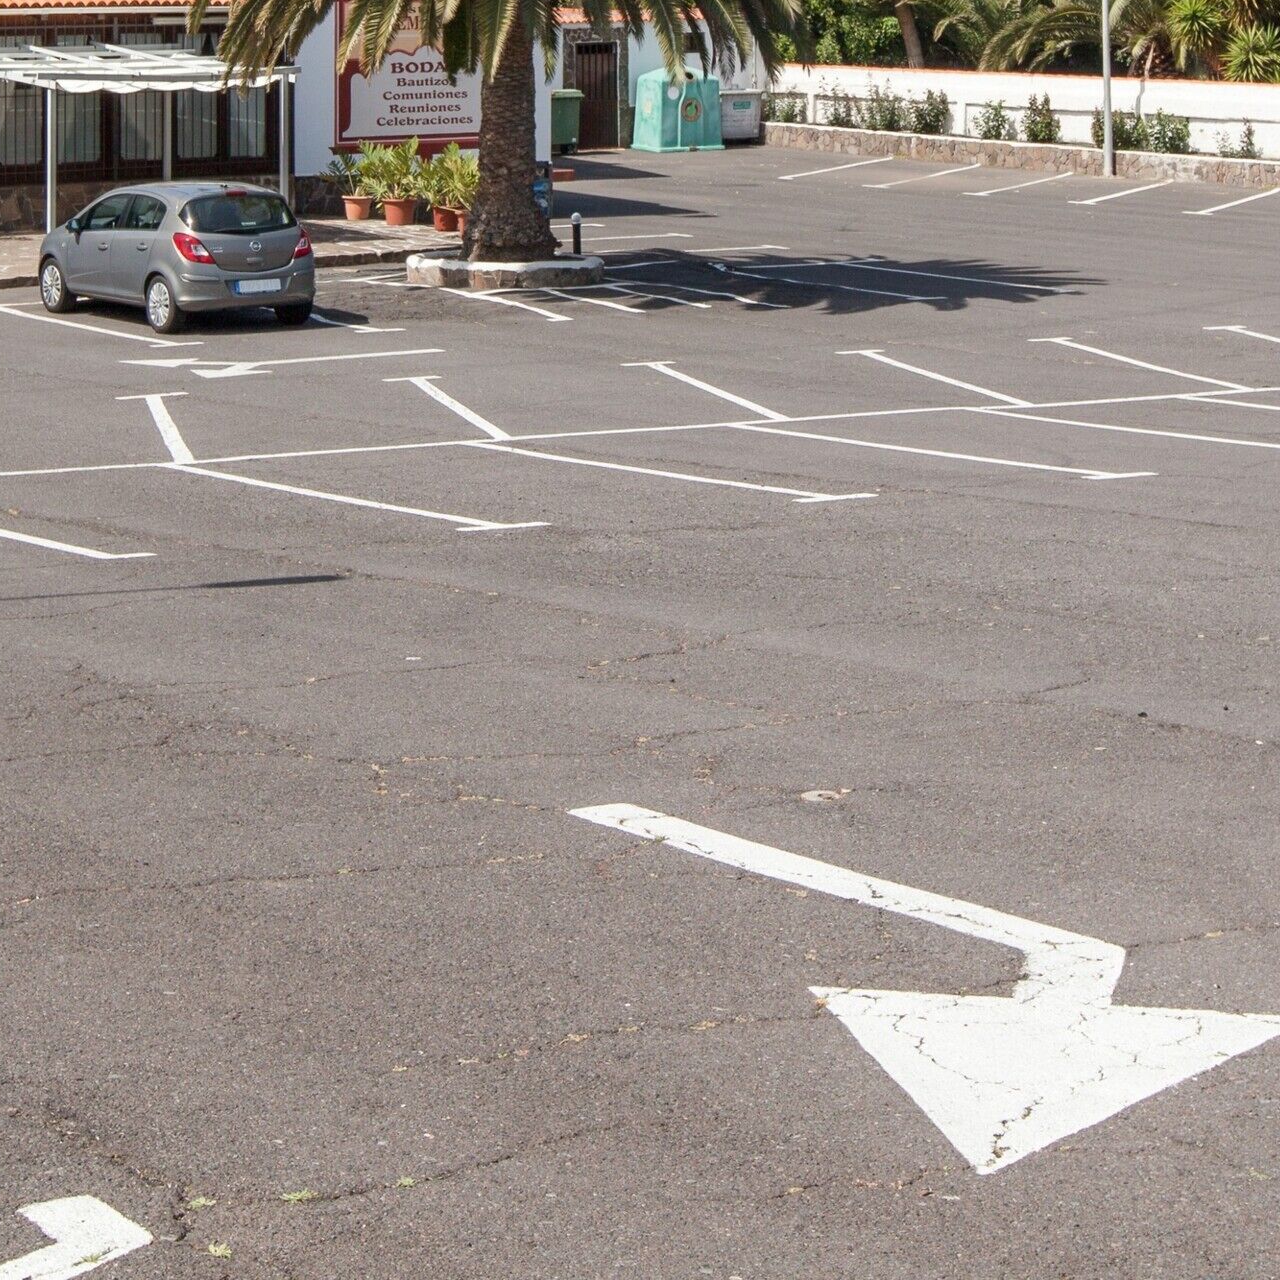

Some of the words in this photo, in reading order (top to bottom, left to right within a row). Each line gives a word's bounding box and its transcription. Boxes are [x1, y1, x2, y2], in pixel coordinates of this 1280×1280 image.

[390, 61, 450, 74] BODA
[382, 90, 468, 101] Comuniones
[389, 103, 462, 114] Reuniones
[376, 116, 474, 127] Celebraciones
